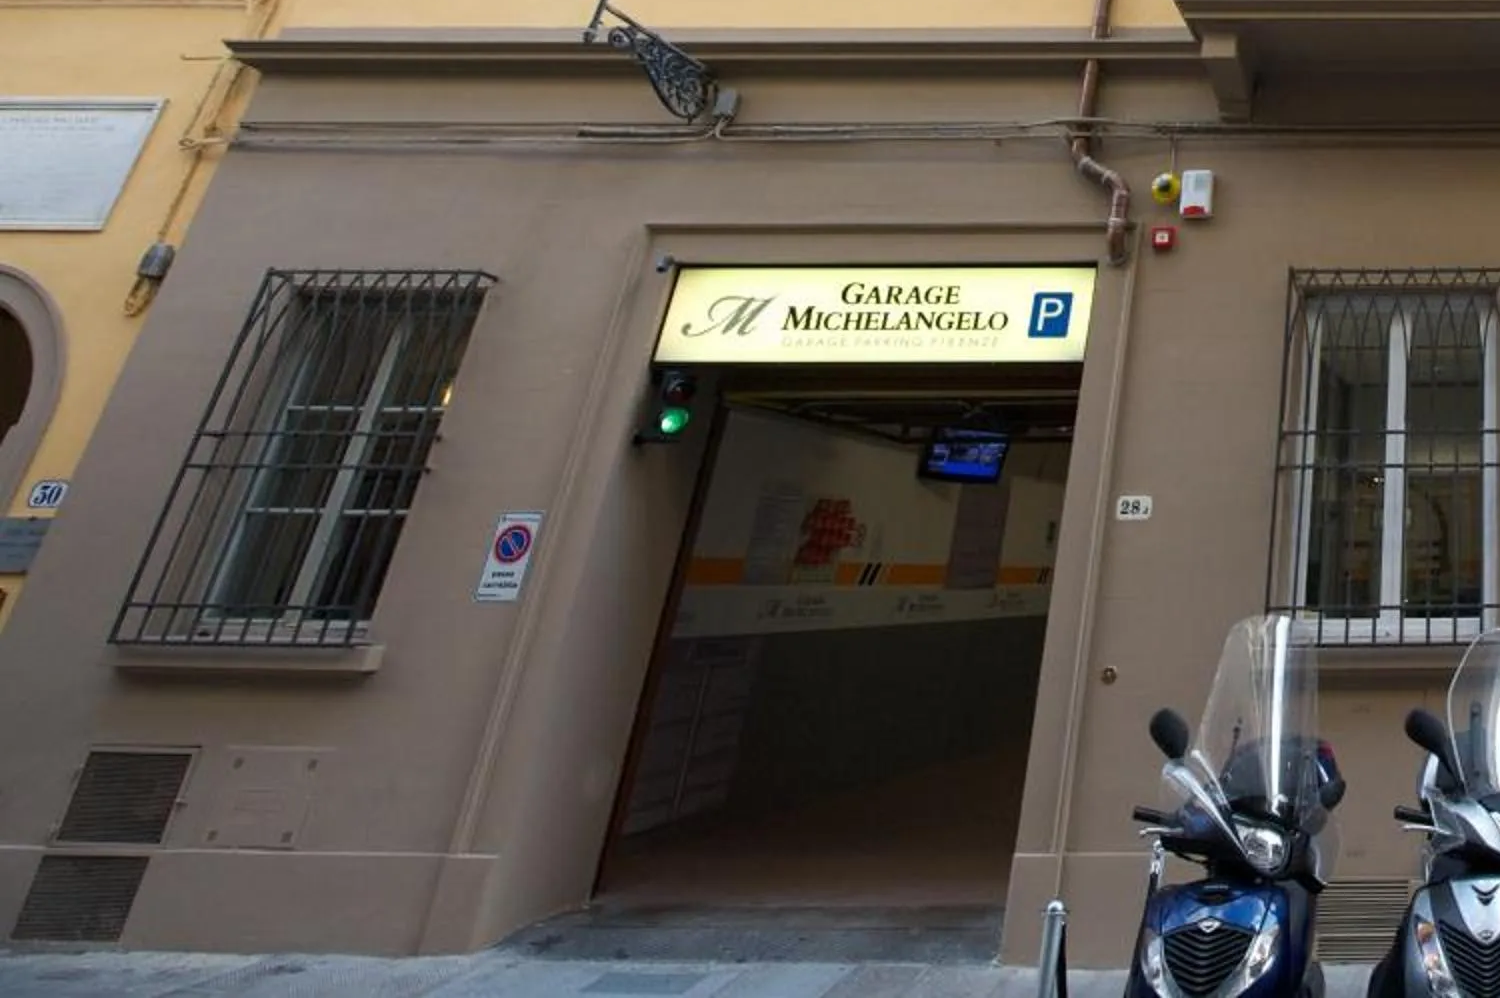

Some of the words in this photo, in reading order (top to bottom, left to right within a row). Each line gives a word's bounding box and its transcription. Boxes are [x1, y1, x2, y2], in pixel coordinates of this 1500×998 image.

[841, 282, 961, 305] GARAGE
[781, 305, 1009, 331] MICHELANGELO
[1036, 297, 1065, 332] P
